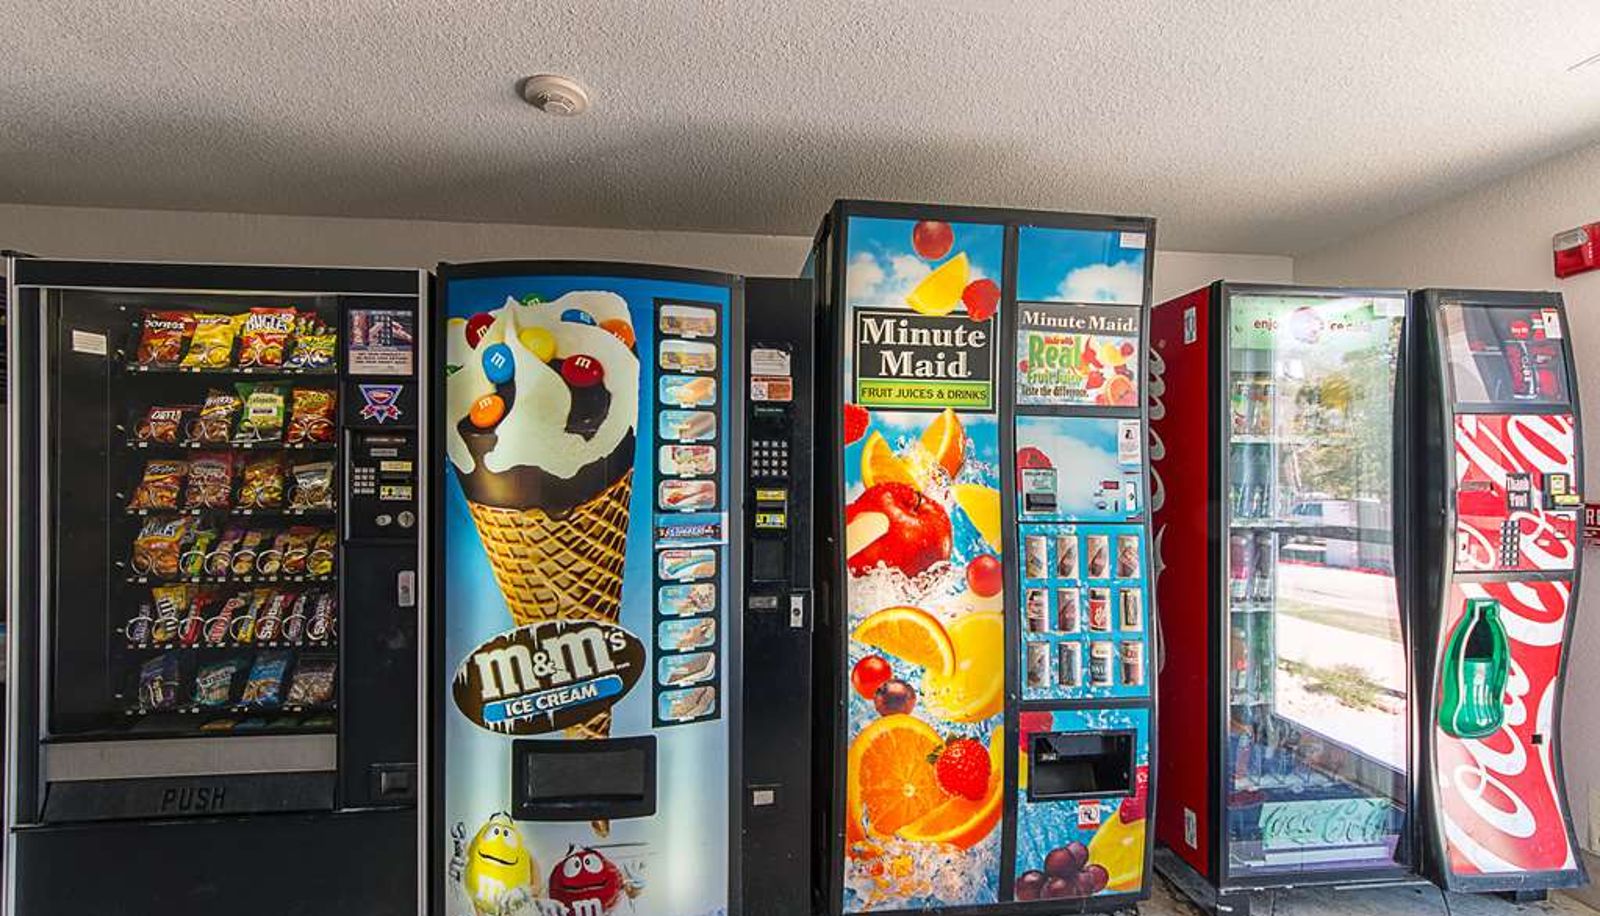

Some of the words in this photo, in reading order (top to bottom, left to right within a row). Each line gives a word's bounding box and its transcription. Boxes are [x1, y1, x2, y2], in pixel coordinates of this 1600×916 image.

[1023, 311, 1086, 329] Minute
[861, 318, 987, 348] Minute
[490, 351, 507, 369] m
[1028, 333, 1082, 370] Real
[574, 355, 592, 370] m
[861, 386, 893, 398] FRUIT
[895, 388, 935, 400] JUICES
[936, 389, 945, 400] &
[947, 389, 988, 401] DRINKS
[1040, 384, 1052, 396] the
[478, 396, 493, 410] m
[505, 698, 534, 717] ICE
[535, 684, 598, 711] CREAM
[161, 787, 226, 812] PUSH
